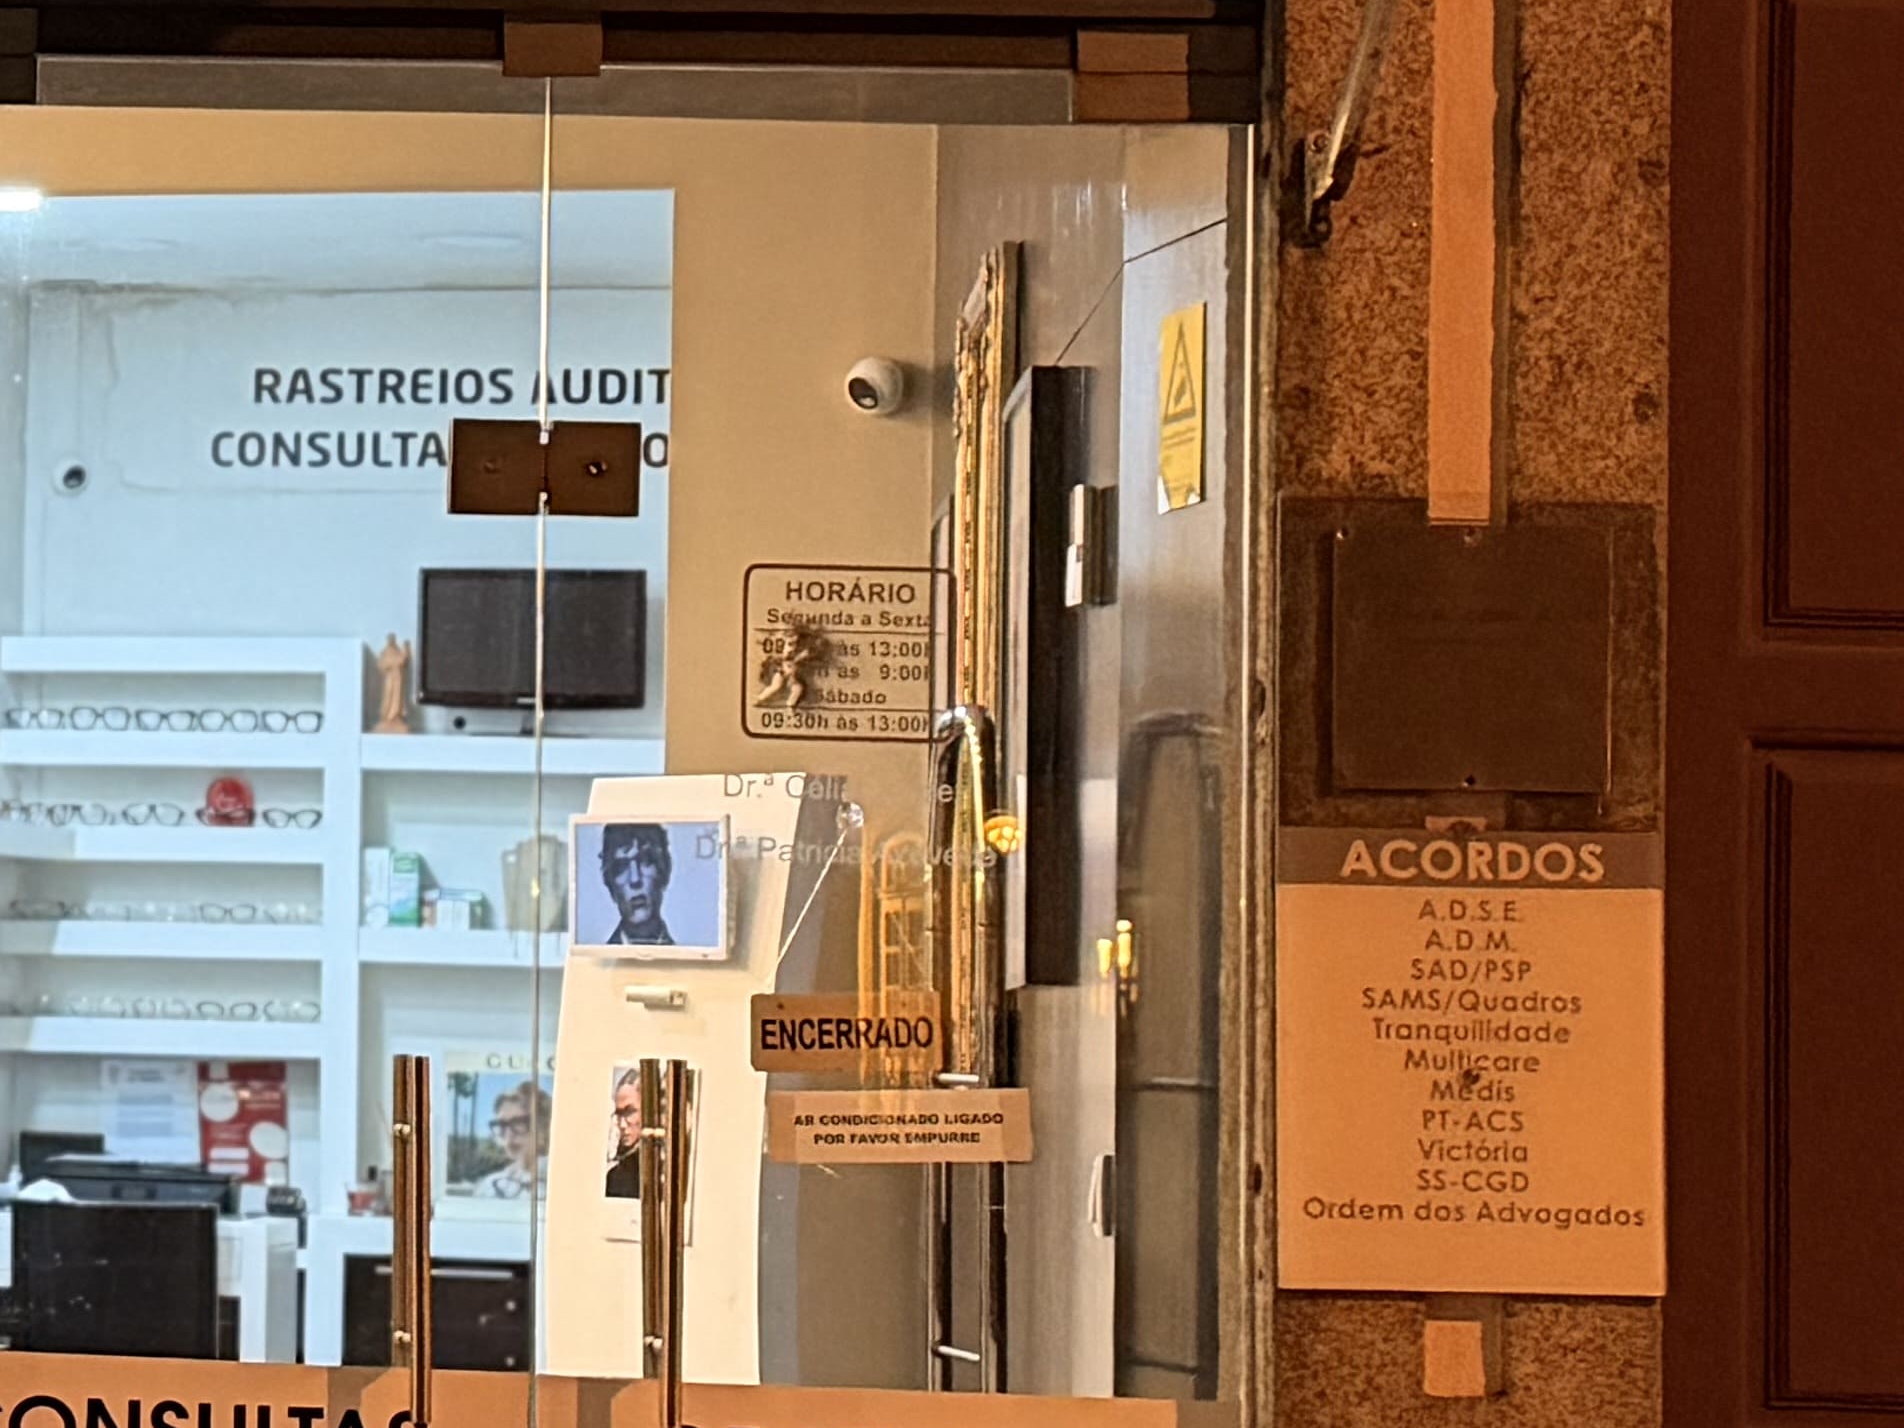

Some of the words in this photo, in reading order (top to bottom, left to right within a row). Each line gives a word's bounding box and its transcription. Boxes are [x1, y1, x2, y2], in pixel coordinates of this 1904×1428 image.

[253, 367, 514, 405] RASTREIOS
[786, 578, 916, 604] HORÁRIO
[1340, 838, 1605, 882] ACORDOS
[1410, 958, 1532, 984] SAD/PSP
[1362, 988, 1582, 1015] SAMS/Quadros
[761, 1017, 934, 1051] ENCERRADO
[1373, 1017, 1571, 1045] Tranquilidade
[1404, 1048, 1541, 1073] Multicare
[944, 1113, 1004, 1124] LIGADO
[1421, 1111, 1524, 1133] PT-ACS
[814, 1134, 845, 1144] POR
[905, 1132, 980, 1144] EMPURRE
[1417, 1138, 1528, 1163] Victória
[1417, 1171, 1530, 1193] SS-CGD
[1303, 1198, 1403, 1222] Ordem
[1415, 1200, 1464, 1223] dos
[1477, 1201, 1645, 1230] Advogados
